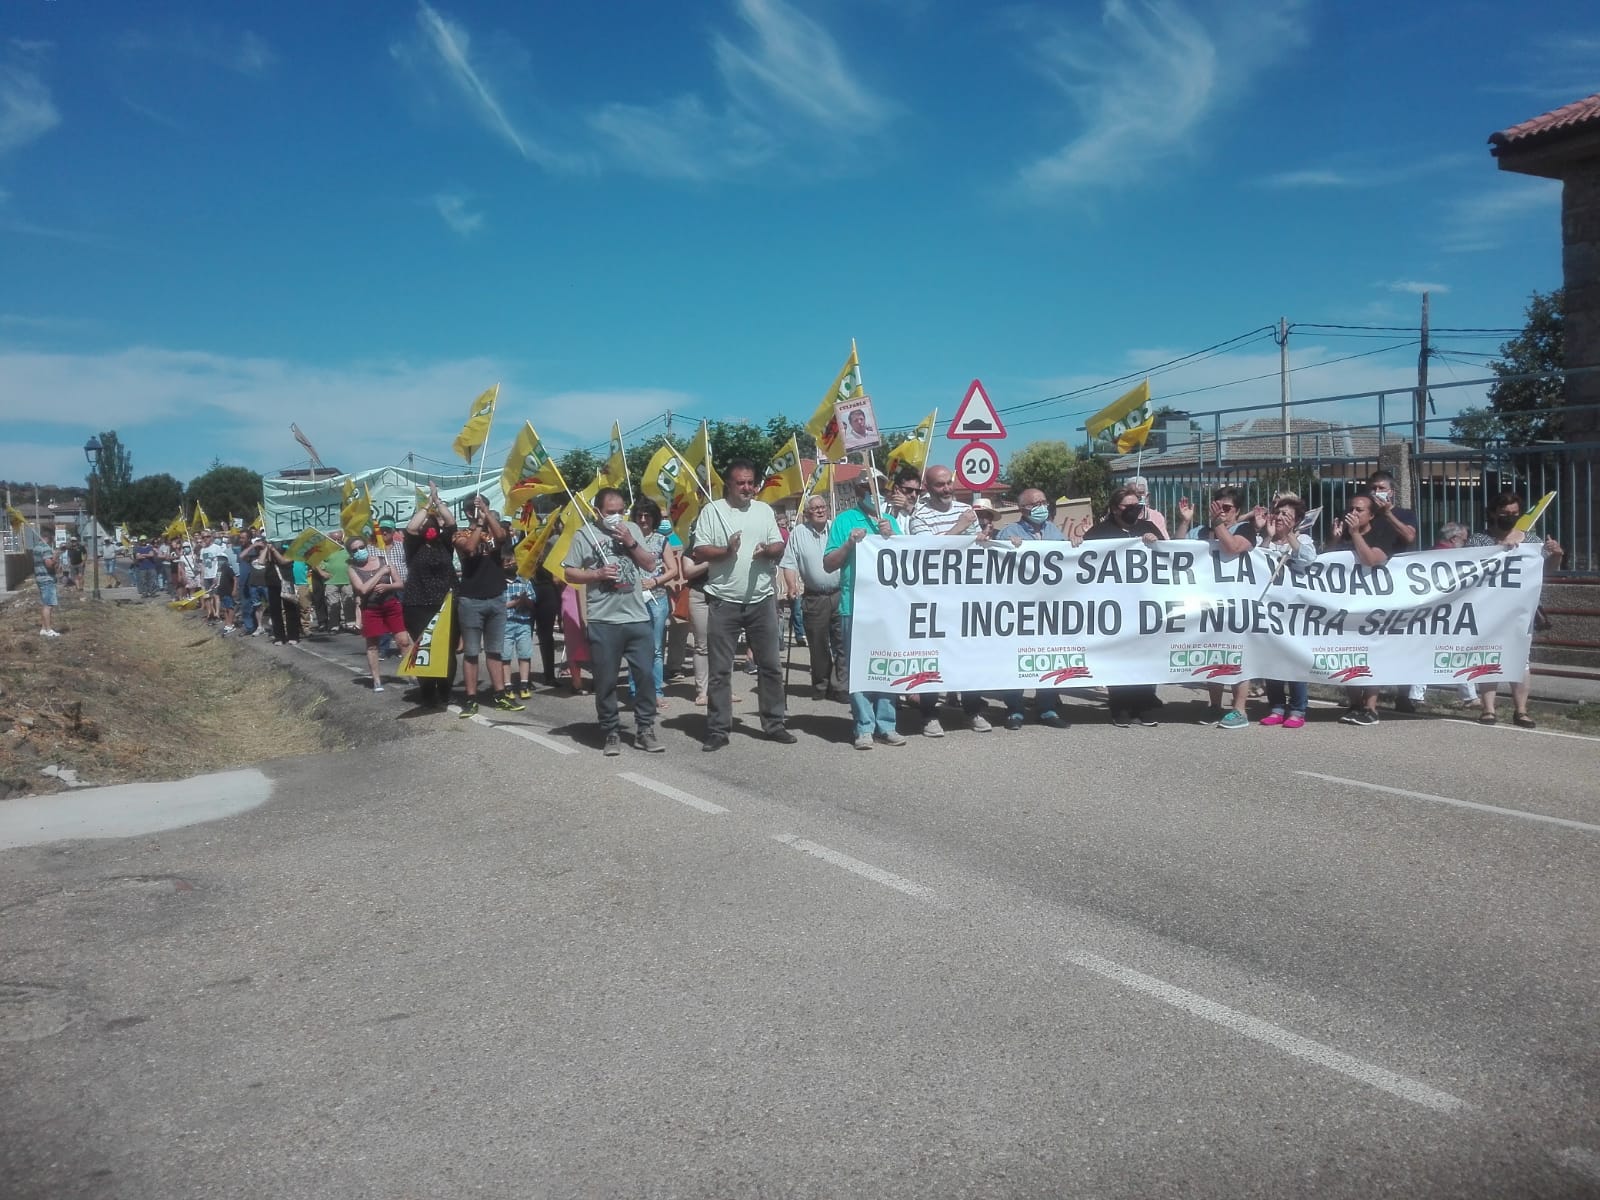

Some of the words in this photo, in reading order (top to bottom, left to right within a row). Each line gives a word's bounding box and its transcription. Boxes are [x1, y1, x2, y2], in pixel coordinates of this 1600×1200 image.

[965, 457, 990, 475] 20
[877, 548, 1065, 589] QUEREMOS
[1076, 549, 1195, 585] SABER
[1213, 550, 1257, 585] LA
[1268, 554, 1394, 596] VERDAD
[1407, 555, 1523, 595] SOBRE
[909, 602, 946, 638] EL
[961, 600, 1122, 638] INCENDIO
[1139, 600, 1186, 635] DE
[1199, 599, 1349, 637] NUESTRA
[1360, 602, 1478, 637] SIERRA
[1018, 654, 1084, 671] COAG
[1170, 650, 1242, 666] COAG
[1314, 653, 1367, 670] COAG
[1435, 652, 1500, 668] COAG
[870, 658, 937, 676] COAG
